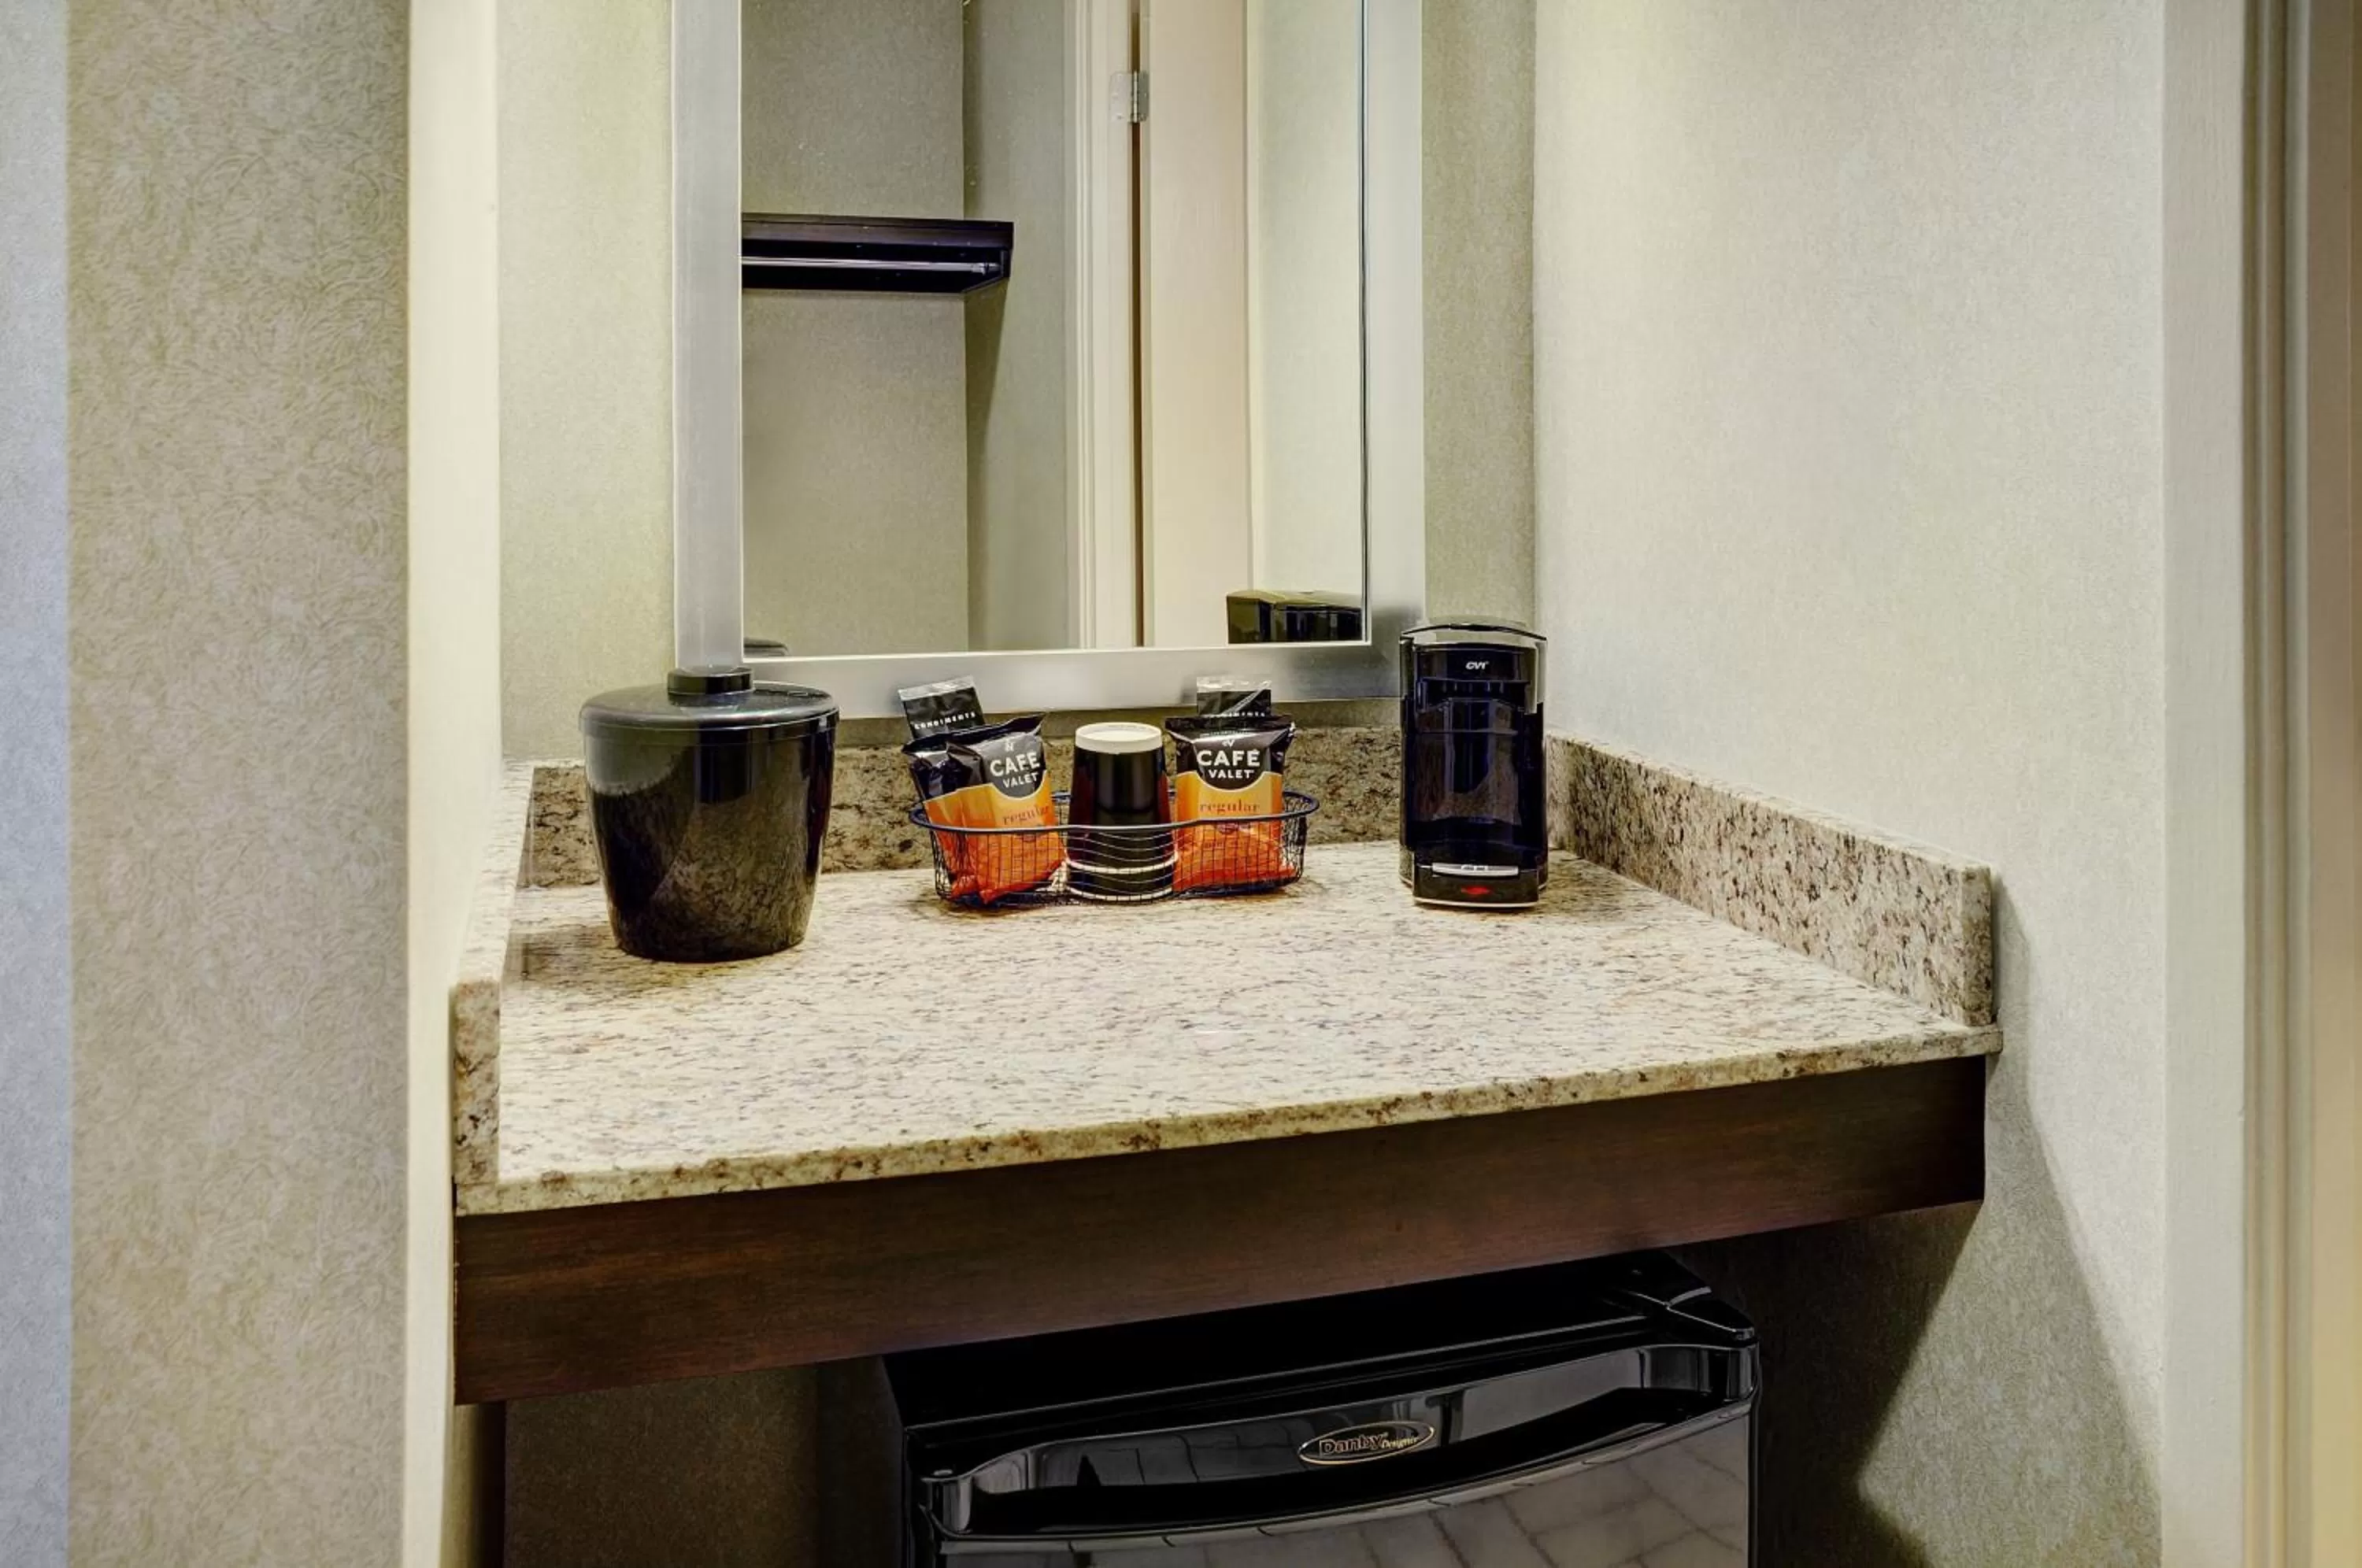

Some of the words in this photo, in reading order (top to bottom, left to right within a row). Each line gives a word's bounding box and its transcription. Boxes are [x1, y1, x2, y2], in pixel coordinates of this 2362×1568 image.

[1002, 771, 1038, 788] VALET
[1208, 769, 1251, 778] VALET
[1002, 804, 1050, 826] regular
[1200, 799, 1260, 815] regular
[1320, 1433, 1383, 1456] Danby
